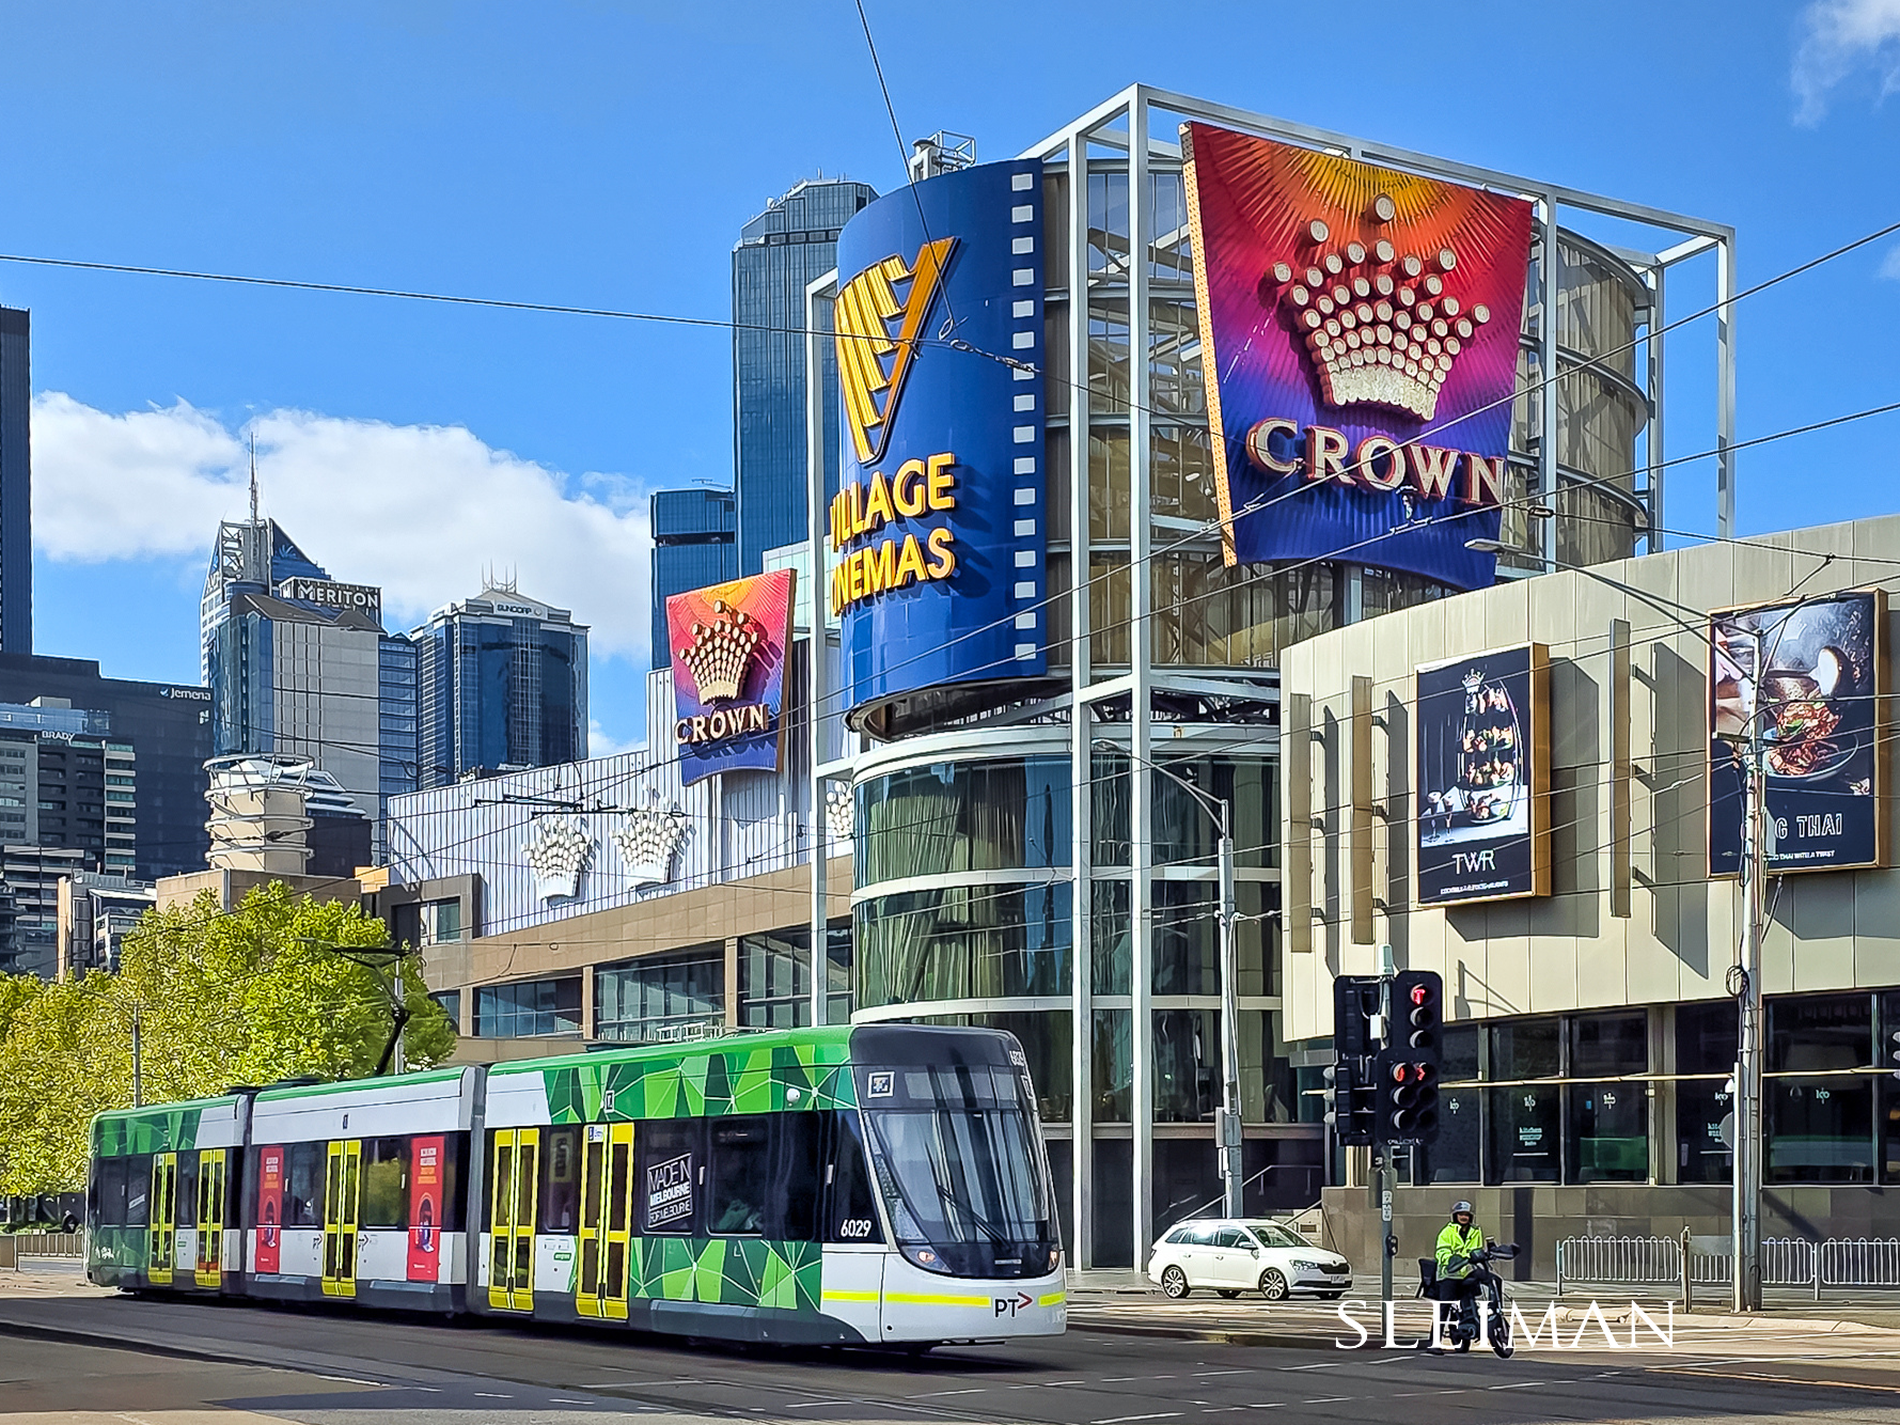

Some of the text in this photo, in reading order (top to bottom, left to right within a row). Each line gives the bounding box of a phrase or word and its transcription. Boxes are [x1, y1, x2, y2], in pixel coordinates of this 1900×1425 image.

[1247, 417, 1506, 505] CROWN
[298, 585, 378, 608] MERITON
[170, 687, 211, 701] Jemena
[675, 704, 768, 745] CROWN
[42, 731, 75, 742] BRADY
[1796, 813, 1842, 838] THAI
[1452, 850, 1496, 874] TWR
[841, 1219, 872, 1237] 6029
